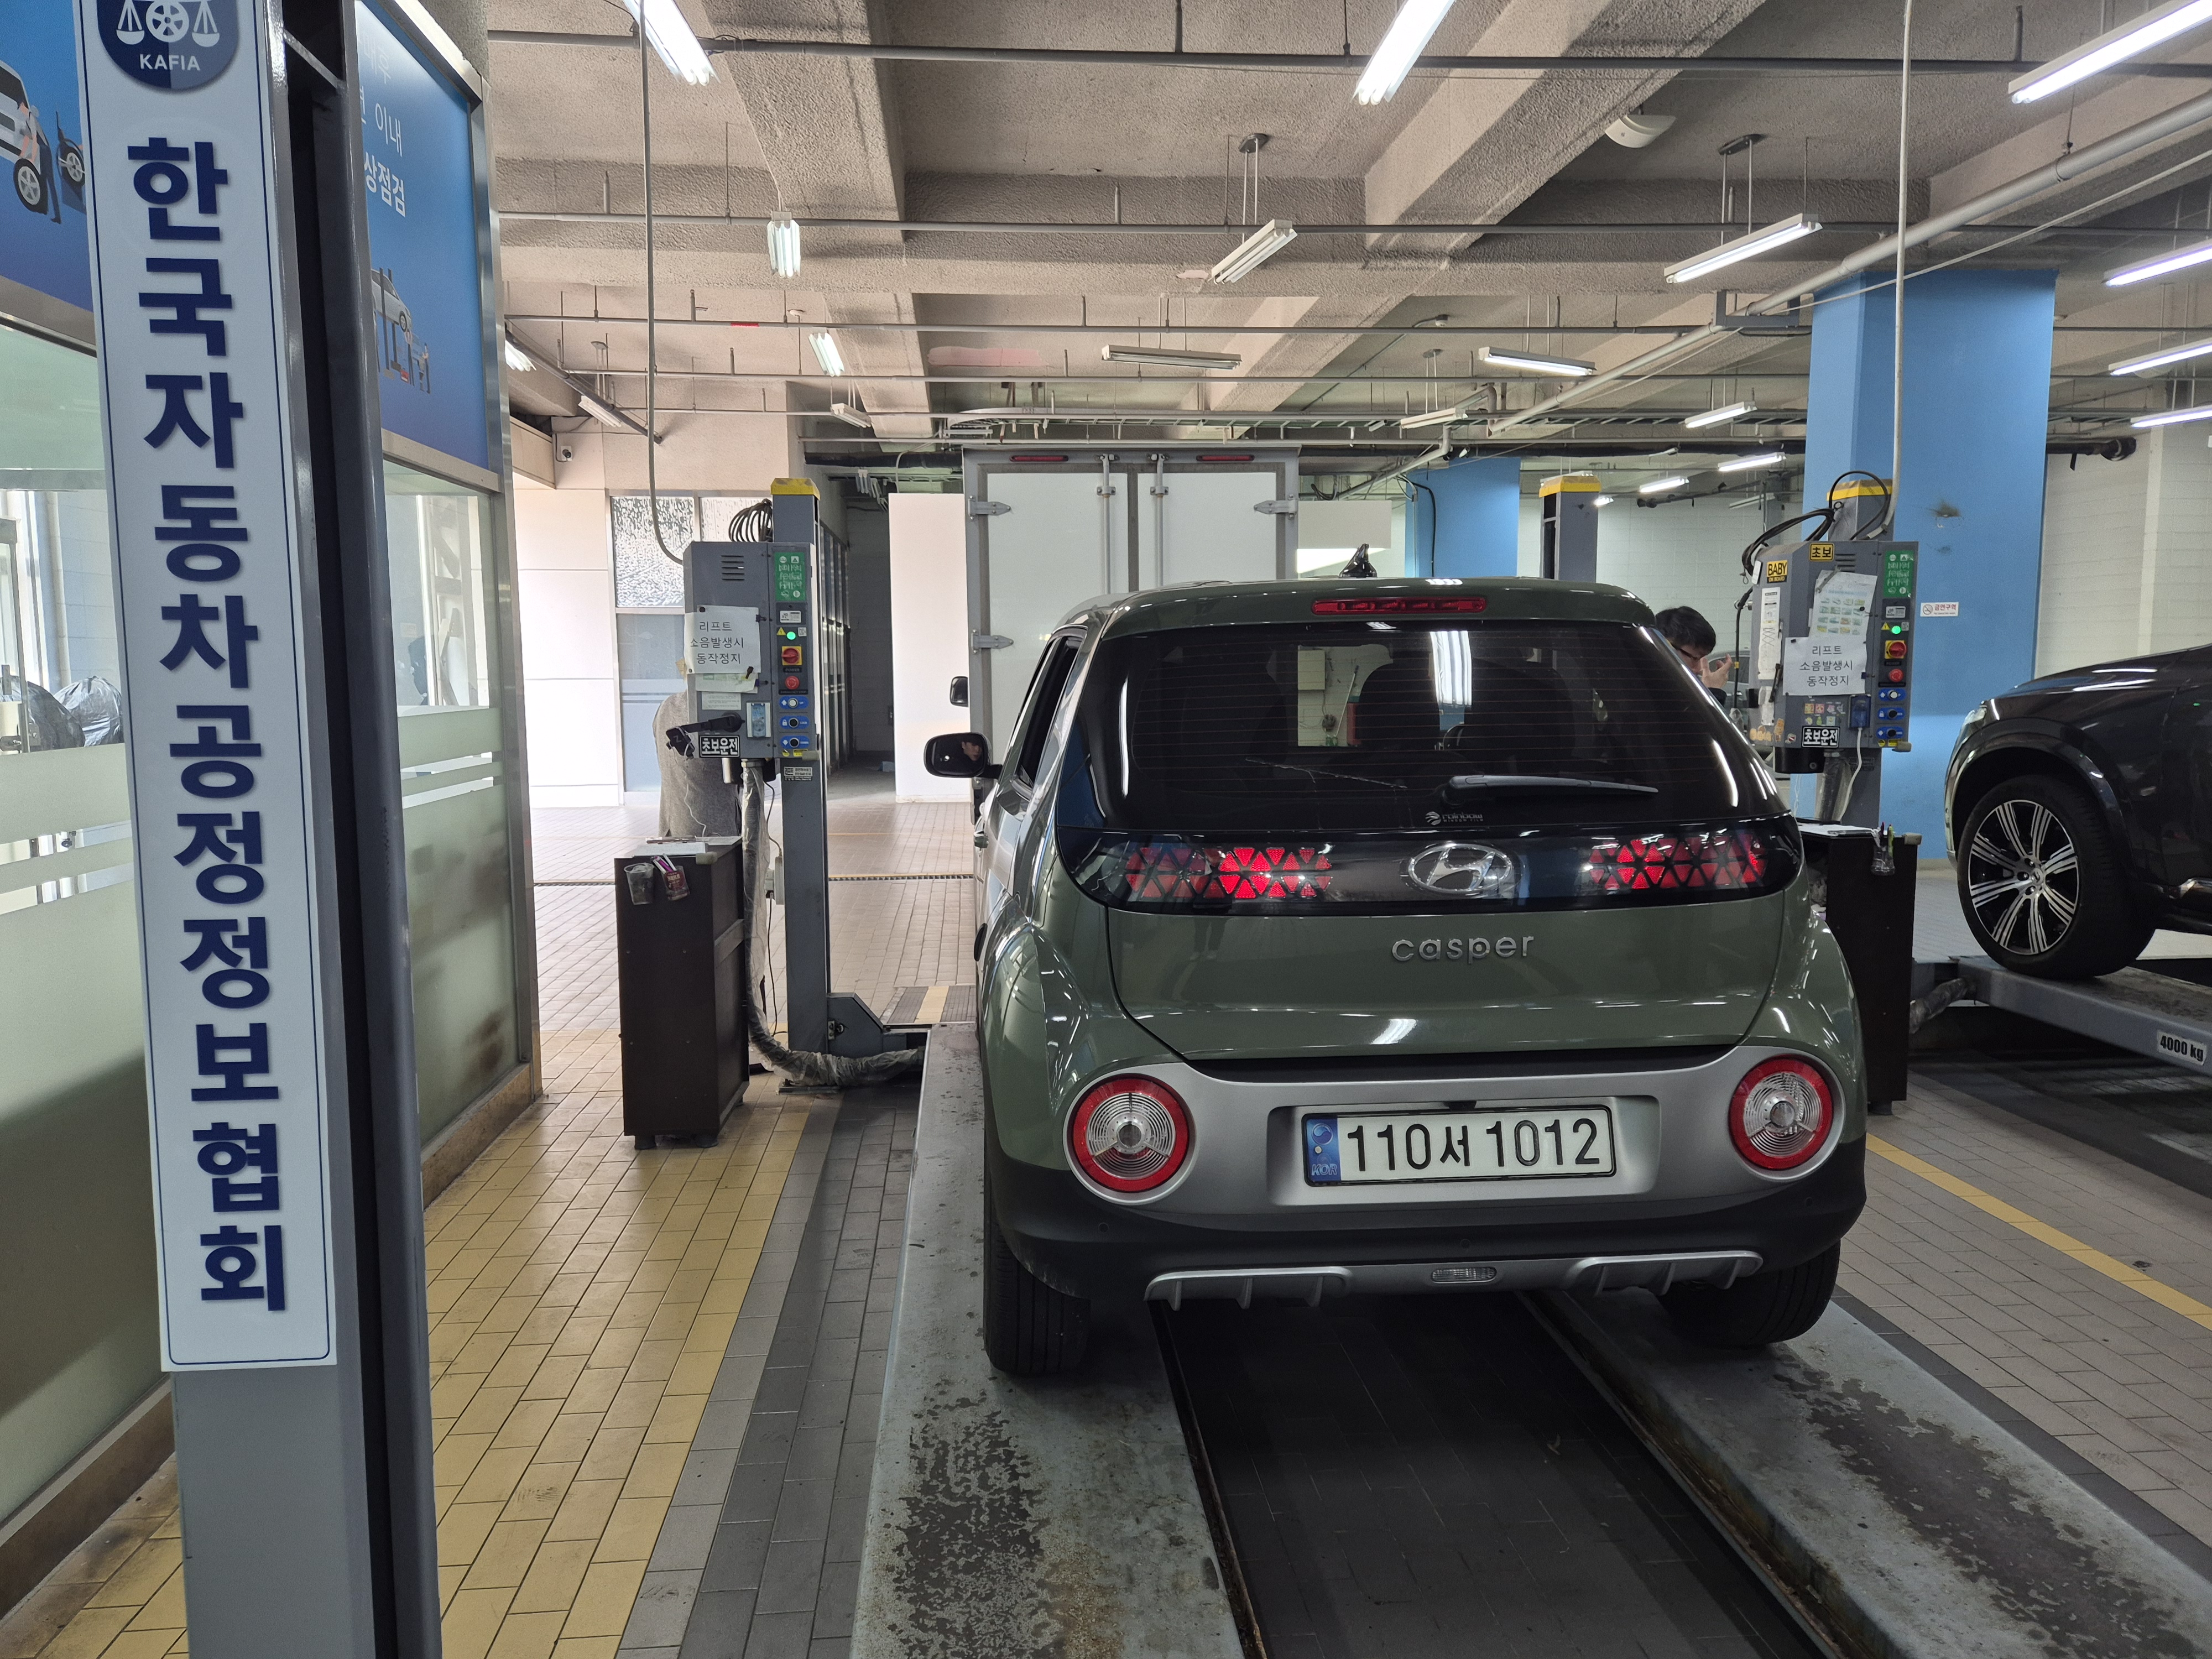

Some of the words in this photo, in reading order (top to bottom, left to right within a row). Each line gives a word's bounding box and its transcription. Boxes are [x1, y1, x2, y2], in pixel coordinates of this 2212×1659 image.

[139, 54, 201, 71] KAFIA
[375, 103, 403, 157] 이내
[1812, 547, 1832, 557] 초보
[1768, 562, 1787, 576] BABY
[699, 621, 733, 632] 리프트
[690, 637, 744, 649] 소음발생시
[1812, 645, 1842, 656] 리프트
[696, 653, 740, 664] 동작정지
[1799, 660, 1853, 671] 소음발생시
[1807, 675, 1849, 687] 동작정지
[128, 137, 285, 1311] 한국자동차공정정보협회
[1803, 729, 1838, 745] 초보운전
[701, 737, 738, 755] 초보운전
[1391, 936, 1534, 964] casper
[2160, 1035, 2188, 1055] 4000
[2190, 1044, 2204, 1062] kg
[1311, 1164, 1337, 1176] KOR
